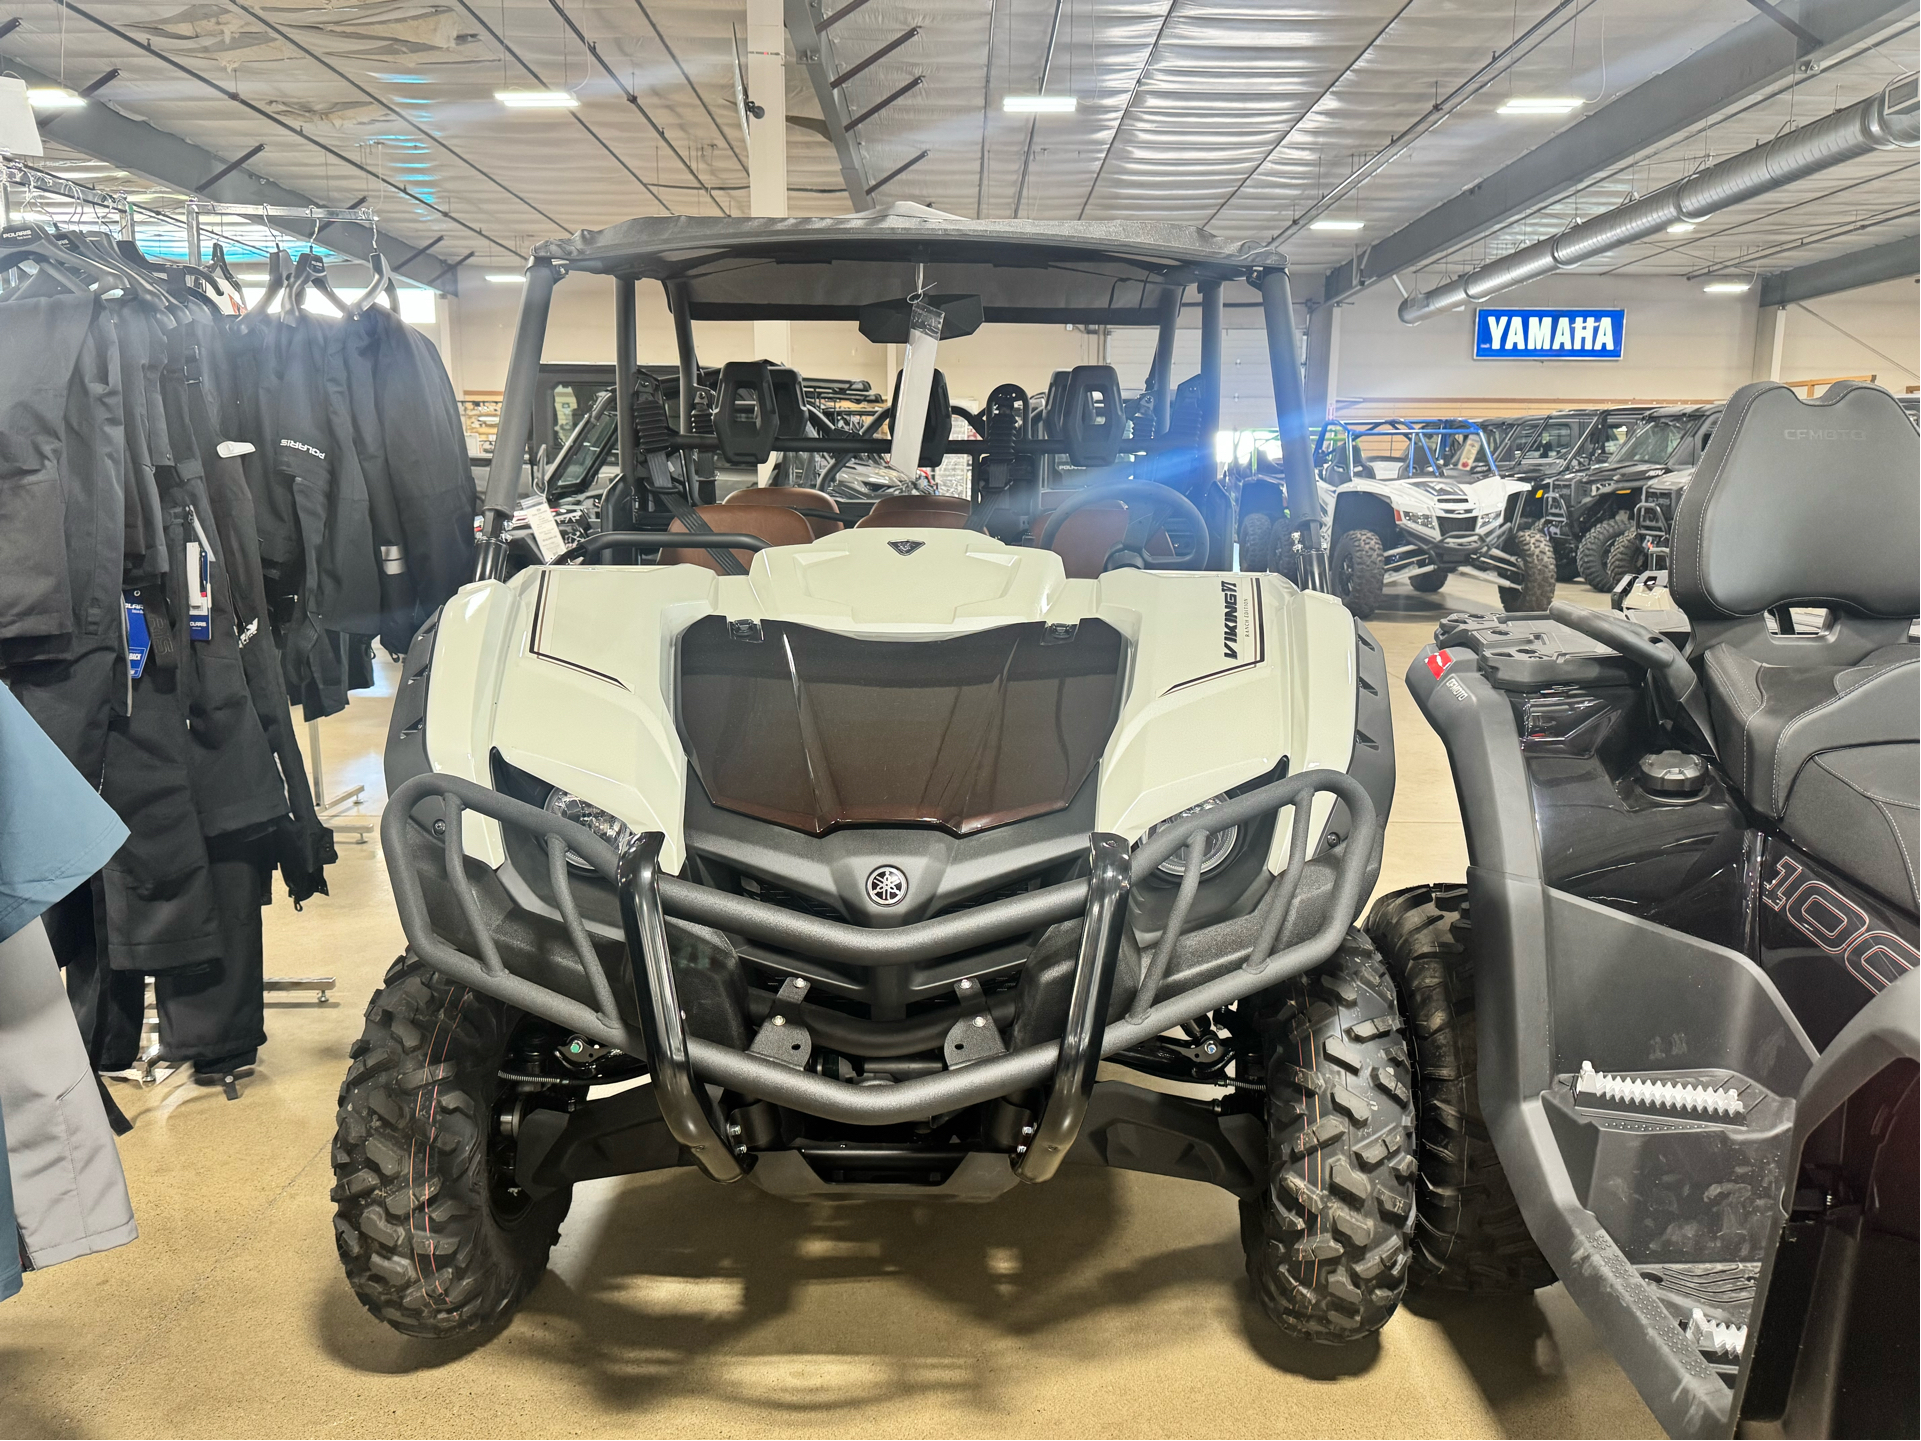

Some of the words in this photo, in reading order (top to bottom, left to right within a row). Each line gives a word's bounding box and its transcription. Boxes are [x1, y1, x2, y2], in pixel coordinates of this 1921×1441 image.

[1487, 316, 1615, 350] YAMAHA
[1783, 429, 1866, 441] CFMOTO
[279, 439, 326, 460] POLARIS
[1223, 592, 1238, 660] VIKING
[1445, 678, 1468, 701] CFMOTO
